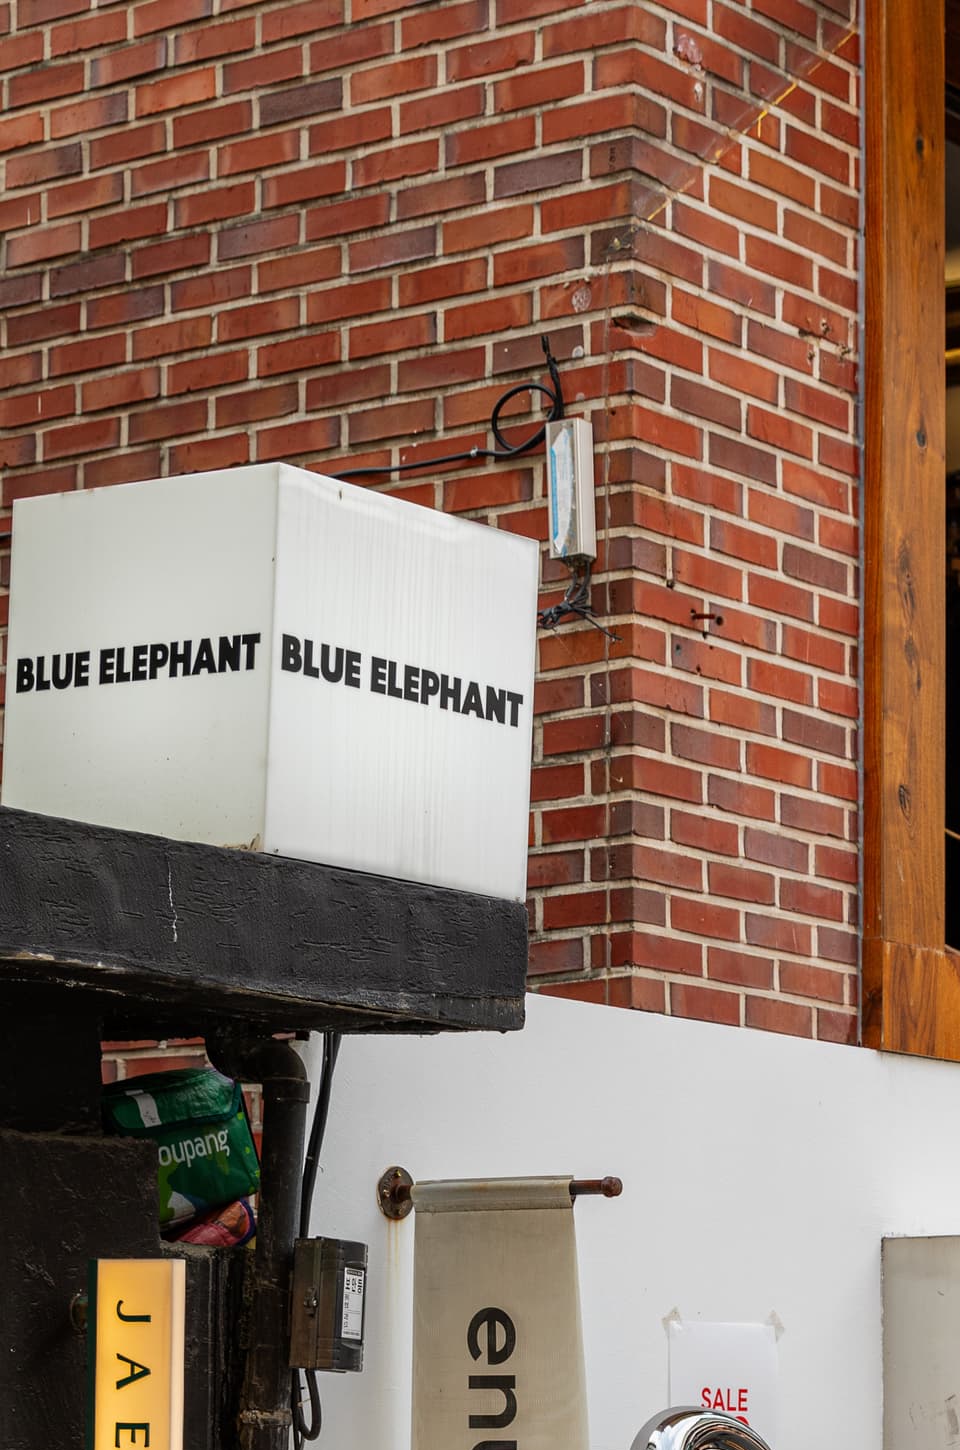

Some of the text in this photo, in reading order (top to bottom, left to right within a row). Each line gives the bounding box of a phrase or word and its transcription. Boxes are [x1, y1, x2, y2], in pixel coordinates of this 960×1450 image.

[16, 632, 261, 693] BLUE ELEPHANT
[281, 633, 524, 728] BLUE ELEPHANT
[158, 1128, 230, 1168] oupang
[701, 1387, 749, 1412] SALE
